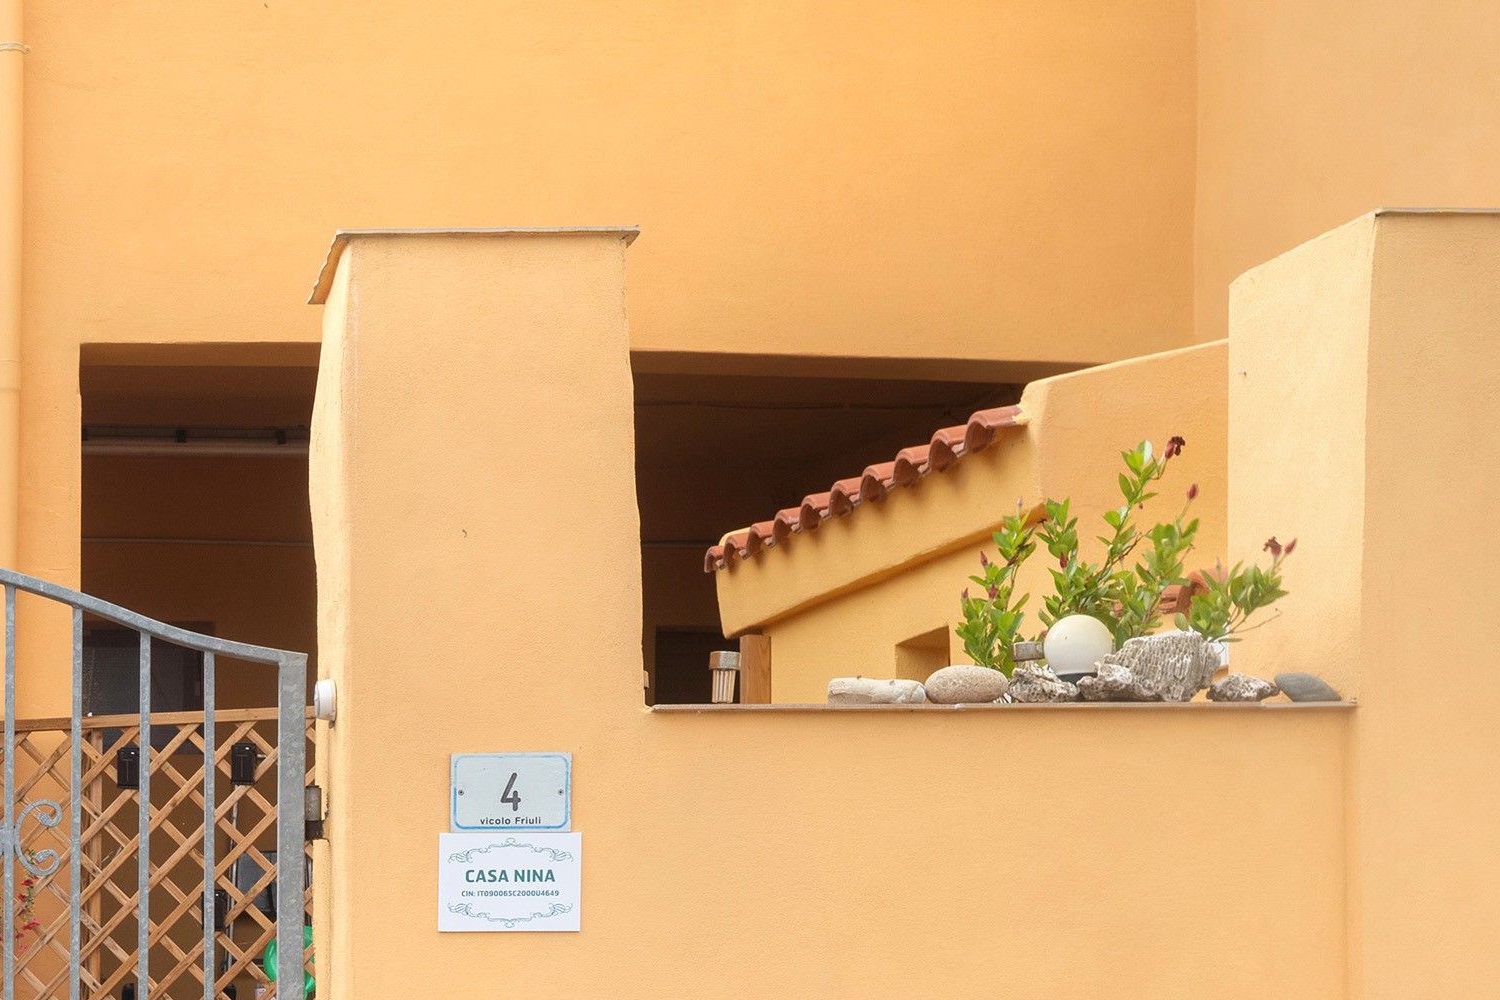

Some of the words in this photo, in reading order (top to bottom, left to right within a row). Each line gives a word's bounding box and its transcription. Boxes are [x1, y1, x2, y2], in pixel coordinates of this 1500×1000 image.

[500, 772, 522, 812] 4
[480, 817, 511, 825] vicolo
[515, 816, 542, 825] Friuli
[465, 869, 509, 882] CASA
[514, 869, 555, 882] NINA
